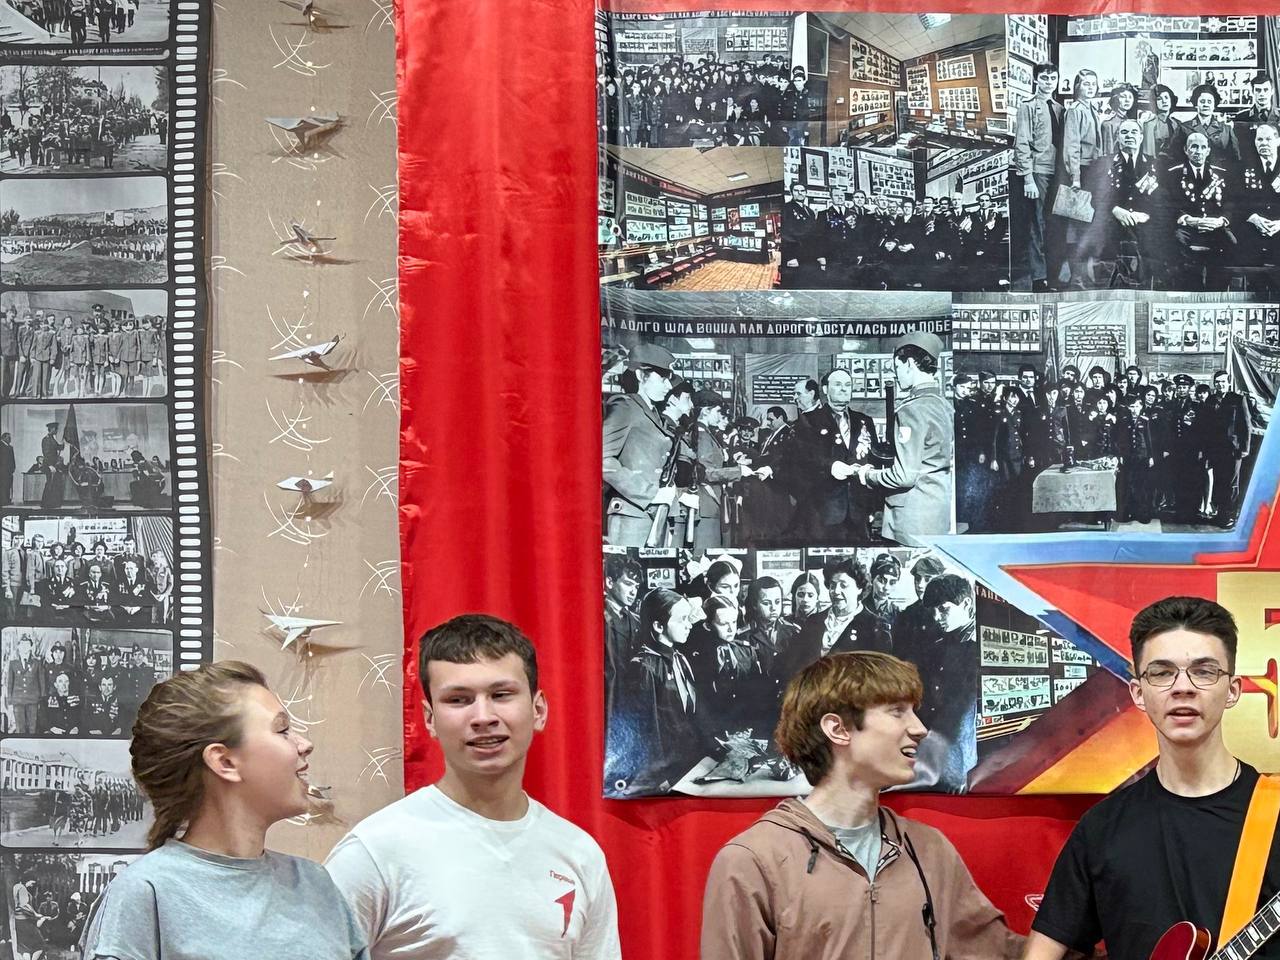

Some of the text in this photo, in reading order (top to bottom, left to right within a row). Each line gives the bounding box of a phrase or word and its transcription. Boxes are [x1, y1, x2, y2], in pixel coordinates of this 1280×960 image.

[620, 319, 660, 333] ДОЛГО
[664, 322, 693, 334] ШЛА
[766, 323, 814, 334] ДОРОГО
[816, 322, 887, 335] ДОСТАЛАСЬ
[890, 322, 916, 335] НАМ
